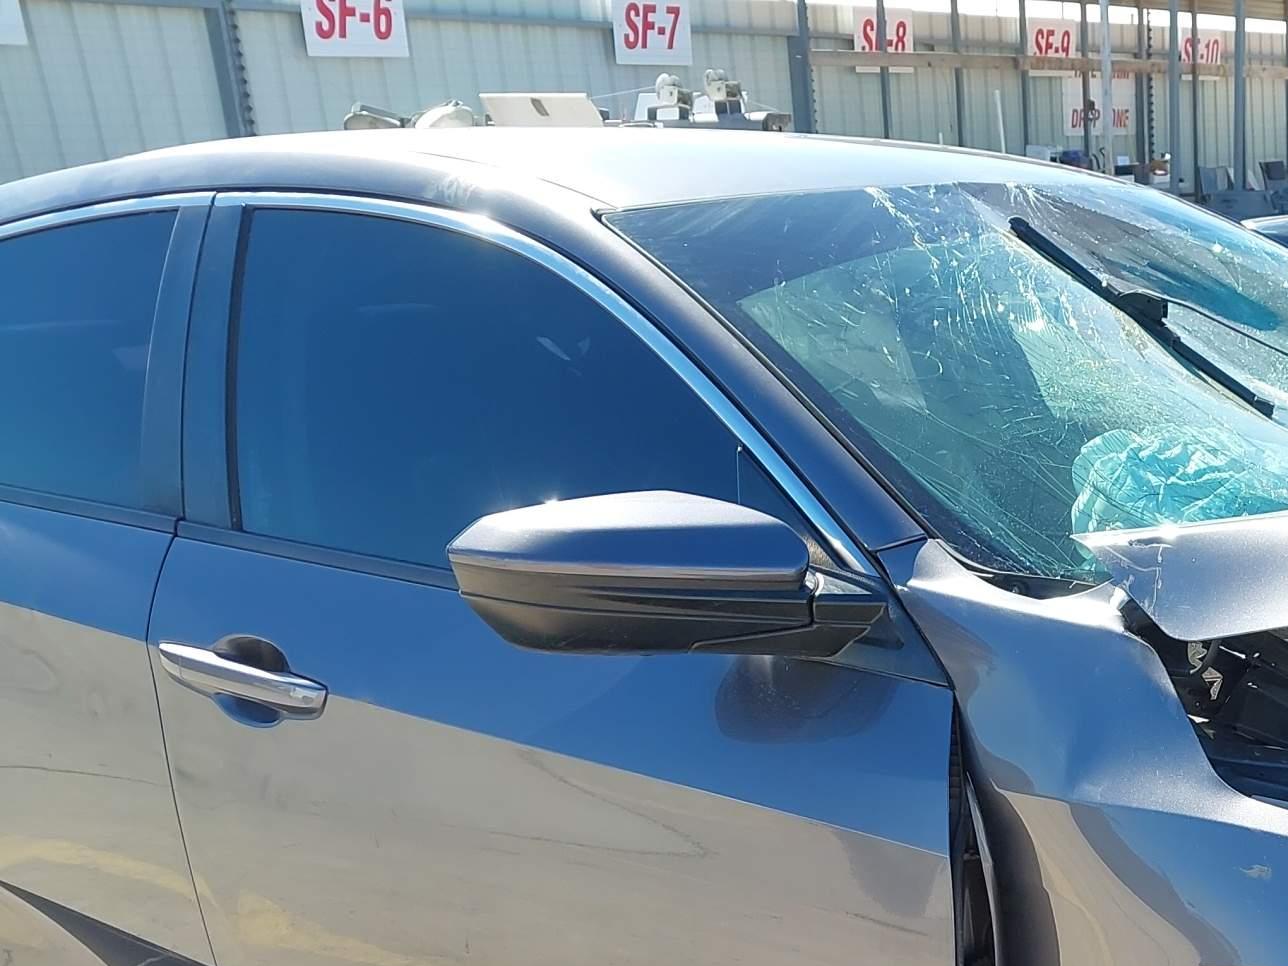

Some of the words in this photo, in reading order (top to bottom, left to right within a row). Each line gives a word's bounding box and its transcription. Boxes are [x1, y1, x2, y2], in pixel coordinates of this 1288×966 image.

[315, 0, 393, 40] SF-6
[623, 2, 681, 50] SF-7
[861, 18, 907, 52] S-8
[1034, 28, 1071, 56] SF-9
